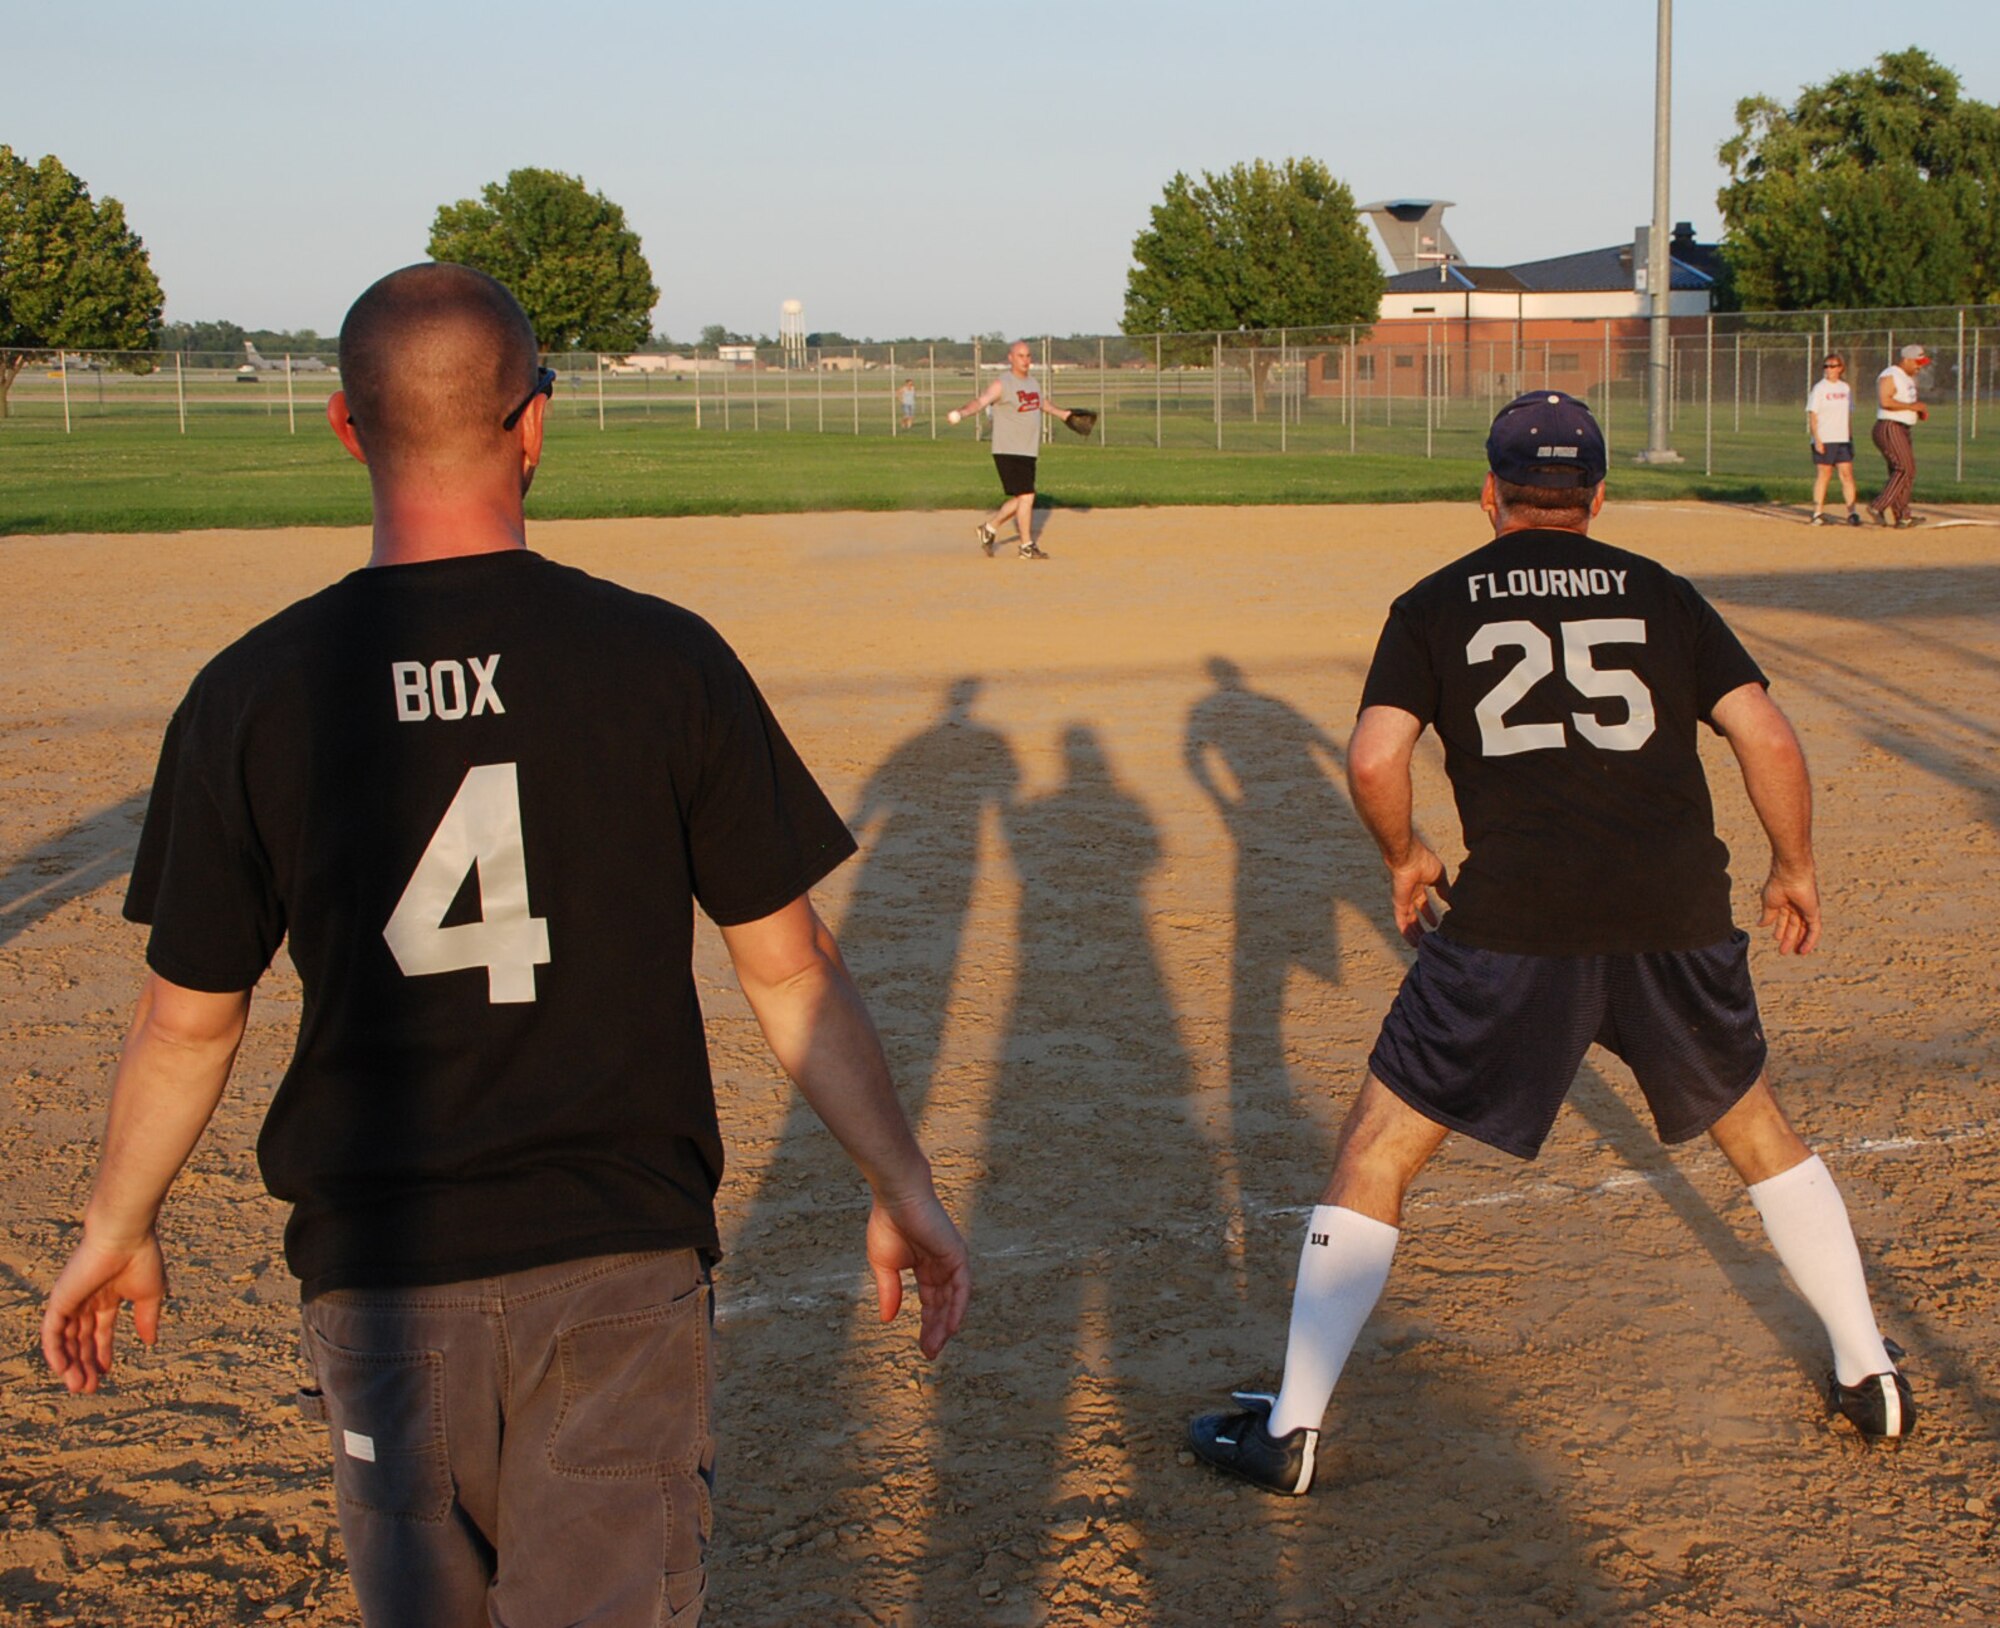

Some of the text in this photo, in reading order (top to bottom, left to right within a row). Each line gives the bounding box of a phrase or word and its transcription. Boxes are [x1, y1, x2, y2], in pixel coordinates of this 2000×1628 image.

[1468, 569, 1628, 602] FLOURNOY
[391, 654, 506, 722] BOX
[1465, 618, 1656, 756] 25
[382, 762, 551, 1004] 4
